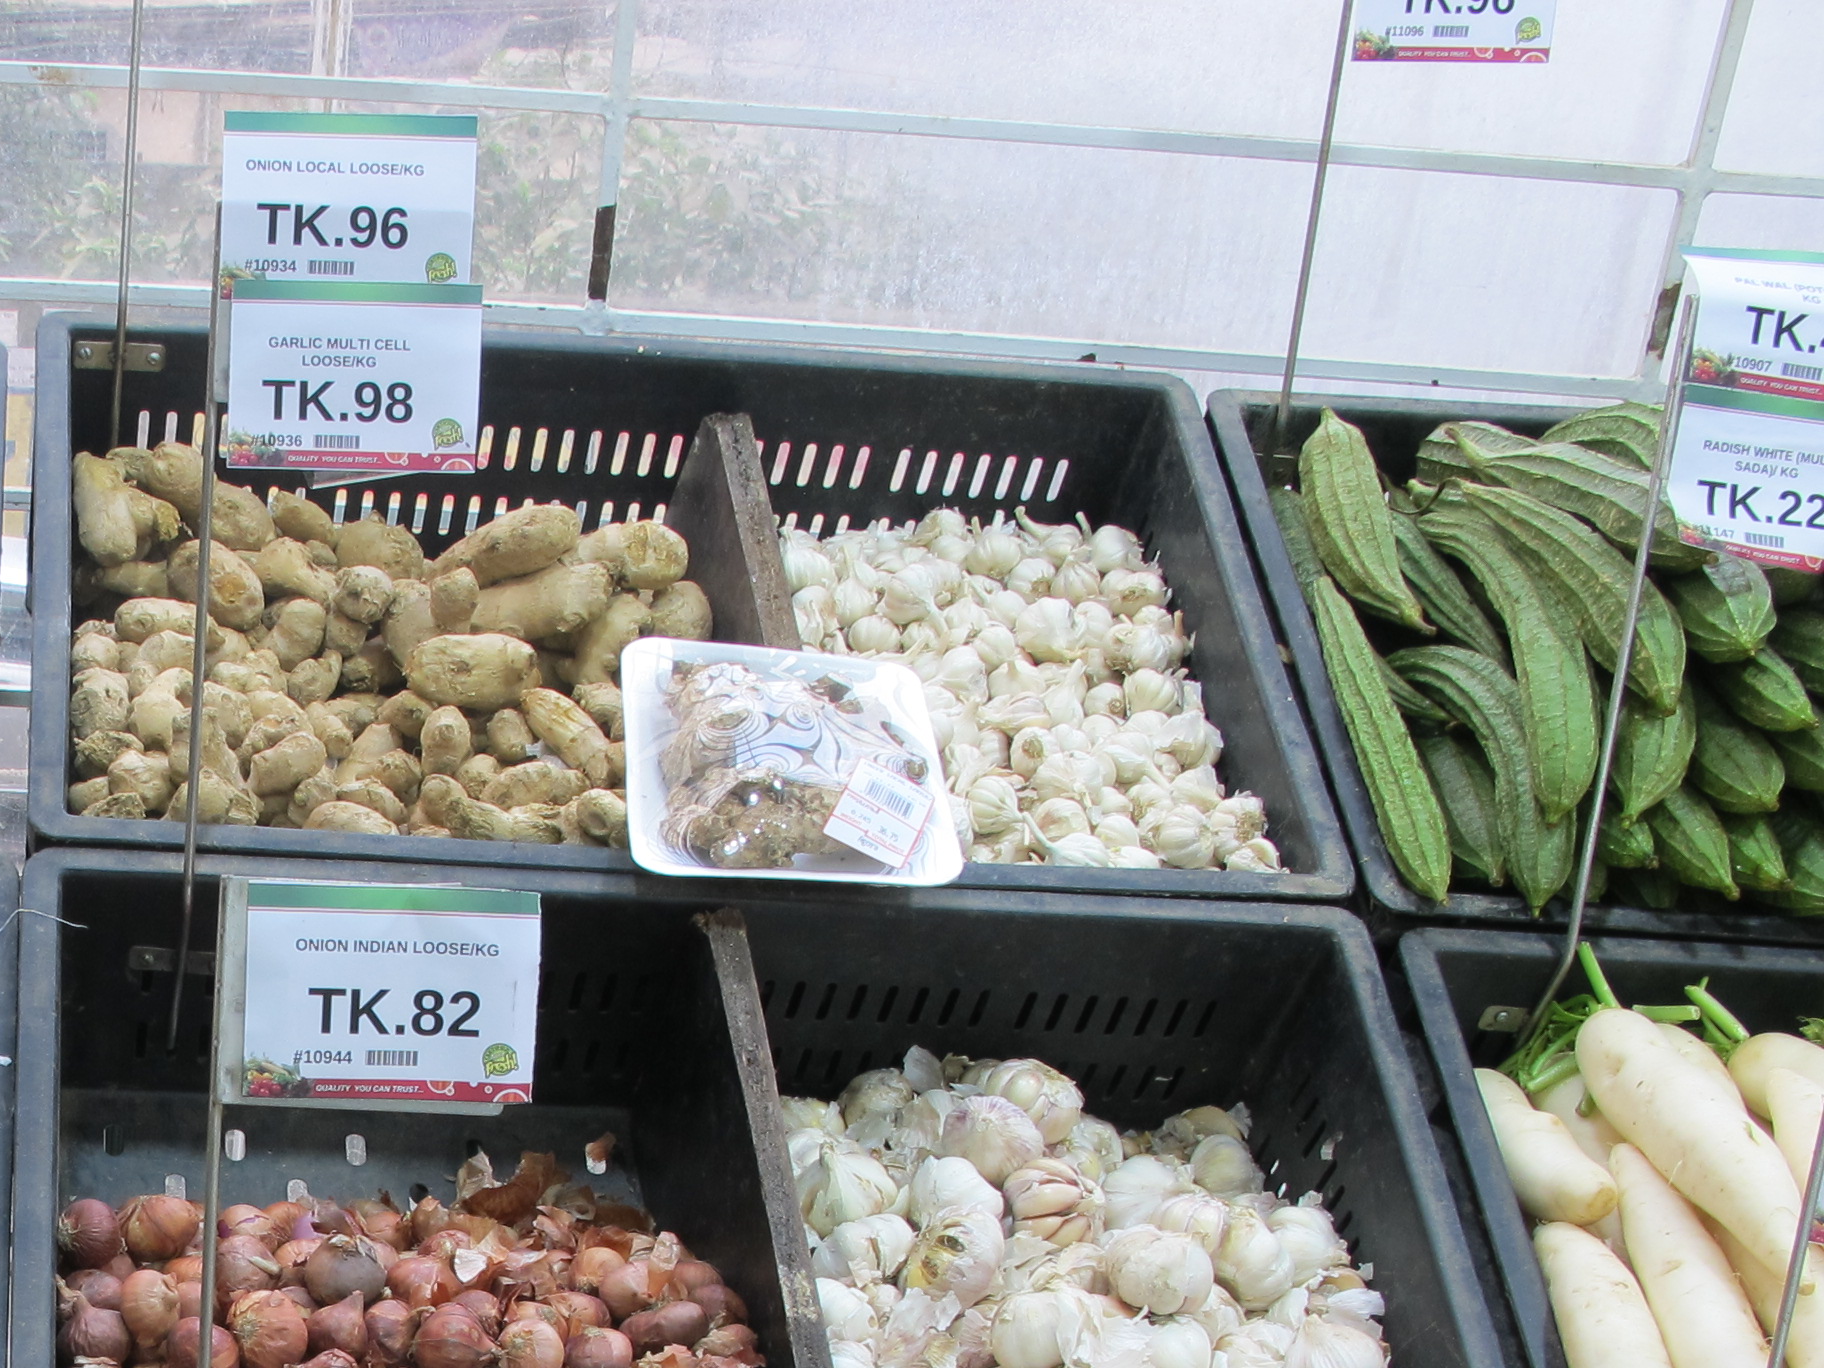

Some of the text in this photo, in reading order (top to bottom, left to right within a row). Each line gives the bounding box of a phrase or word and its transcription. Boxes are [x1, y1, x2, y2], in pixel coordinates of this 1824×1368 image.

[245, 159, 425, 176] ONION LOCAL LOOSE/KG
[256, 202, 409, 249] TK.96
[244, 259, 297, 272] #10934
[1745, 305, 1824, 353] TK.
[268, 336, 411, 351] GARLIC MULTI CELL
[302, 355, 377, 368] LOOSE/KG
[262, 379, 413, 424] TK.98
[250, 433, 303, 447] #10936
[287, 454, 319, 462] QUALITY
[322, 455, 337, 463] YOU
[337, 455, 354, 463] CAN
[1702, 439, 1751, 455] RADISH
[1754, 445, 1793, 462] WHITE
[1734, 461, 1799, 479] SADA)/ KG
[1697, 479, 1824, 530] TK.22
[295, 938, 500, 957] ONION INDIAN LOOSE/KG
[308, 987, 481, 1038] TK.82
[293, 1050, 353, 1065] #10944
[315, 1084, 351, 1092] QUALITY
[372, 1085, 390, 1093] CAN
